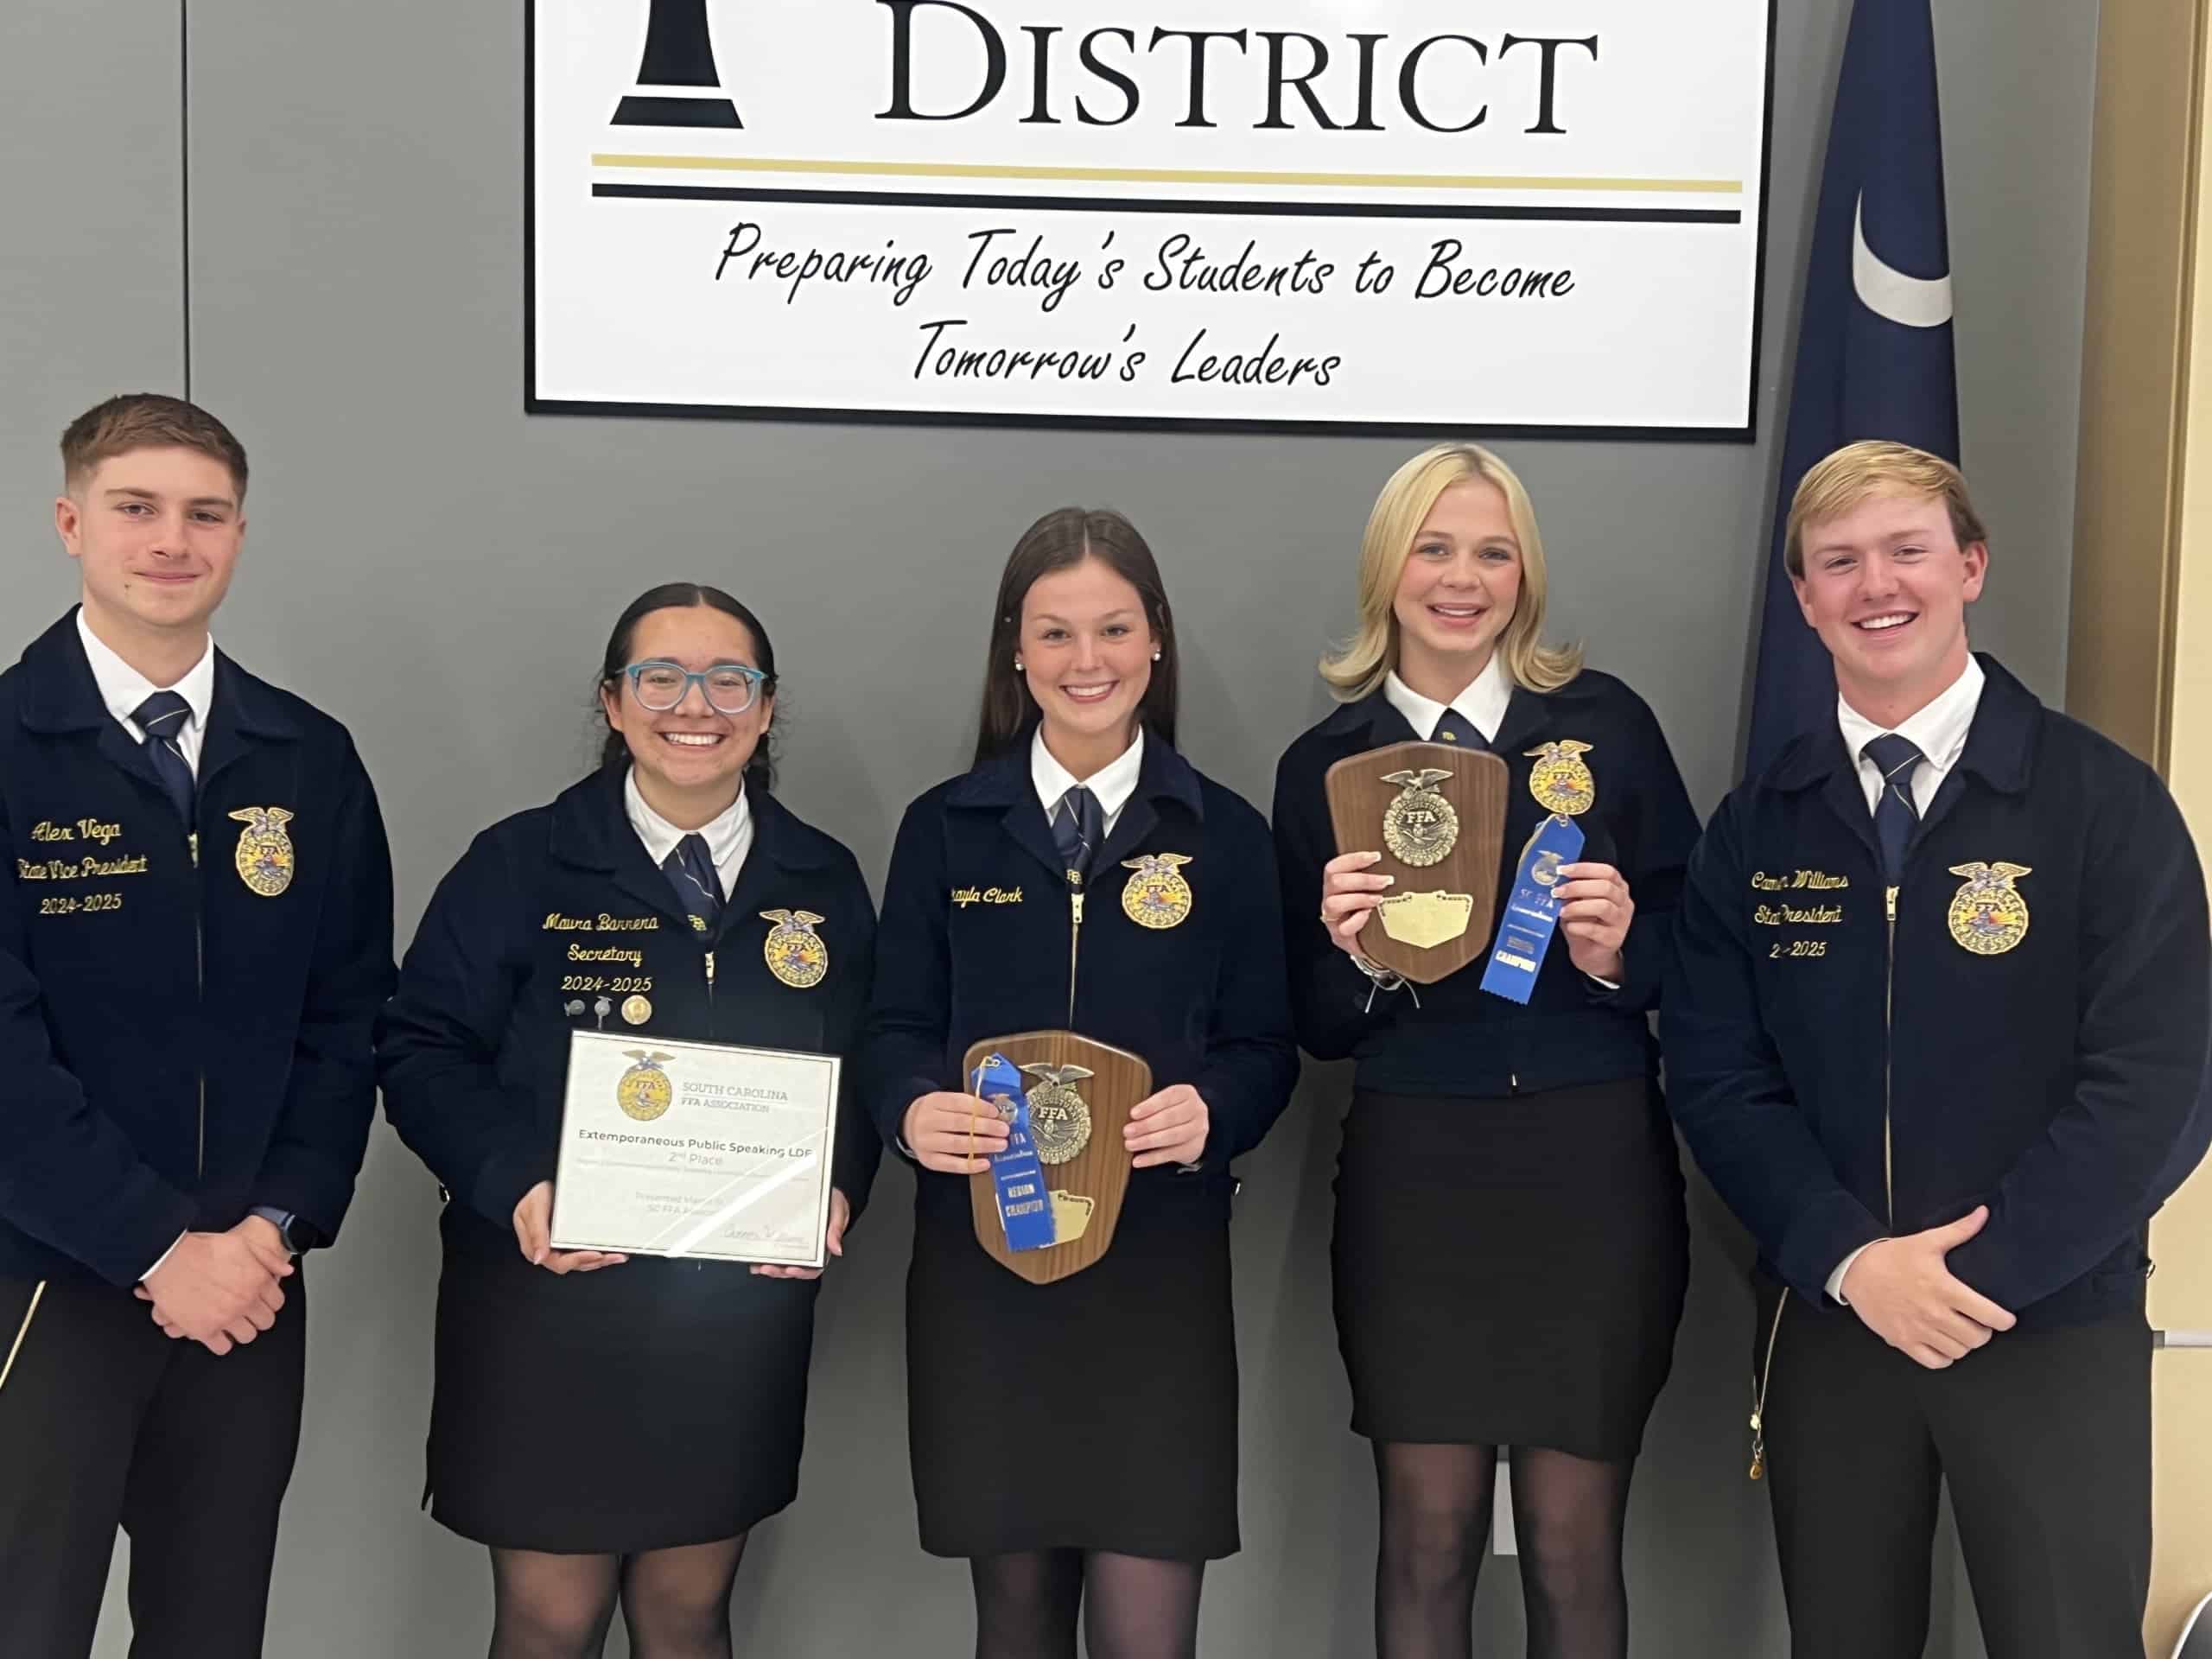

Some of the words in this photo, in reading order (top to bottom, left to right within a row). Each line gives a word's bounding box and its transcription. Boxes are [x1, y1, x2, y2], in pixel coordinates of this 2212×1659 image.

[875, 0, 1599, 134] DISTRICT
[715, 221, 933, 307] Preparing
[963, 228, 1125, 313] Today's
[1143, 233, 1335, 296] Students
[1355, 251, 1395, 295] to
[1414, 238, 1575, 300] Become
[914, 320, 1146, 382] Tomorrow's
[1171, 328, 1341, 386] Leaders
[1406, 810, 1437, 824] FFA
[31, 821, 75, 842] Alex
[76, 818, 122, 846] Vega
[48, 859, 79, 880] Vice
[80, 854, 148, 878] President
[1790, 869, 1849, 890] Williams
[39, 893, 122, 915] 2024-2025
[950, 886, 981, 909] ayla
[982, 887, 1023, 904] Clark
[542, 912, 593, 931] Maura
[567, 943, 643, 968] Secretary
[561, 976, 652, 992] 2024-2025
[683, 1082, 725, 1096] SOUTH
[727, 1086, 788, 1101] CAROLINA
[703, 1099, 770, 1113] ASSOCIATION
[1038, 1107, 1069, 1121] FFA
[579, 1128, 685, 1147] Extemporaneous
[688, 1138, 727, 1152] Public
[728, 1142, 785, 1159] Speaking
[689, 1153, 724, 1166] Place
